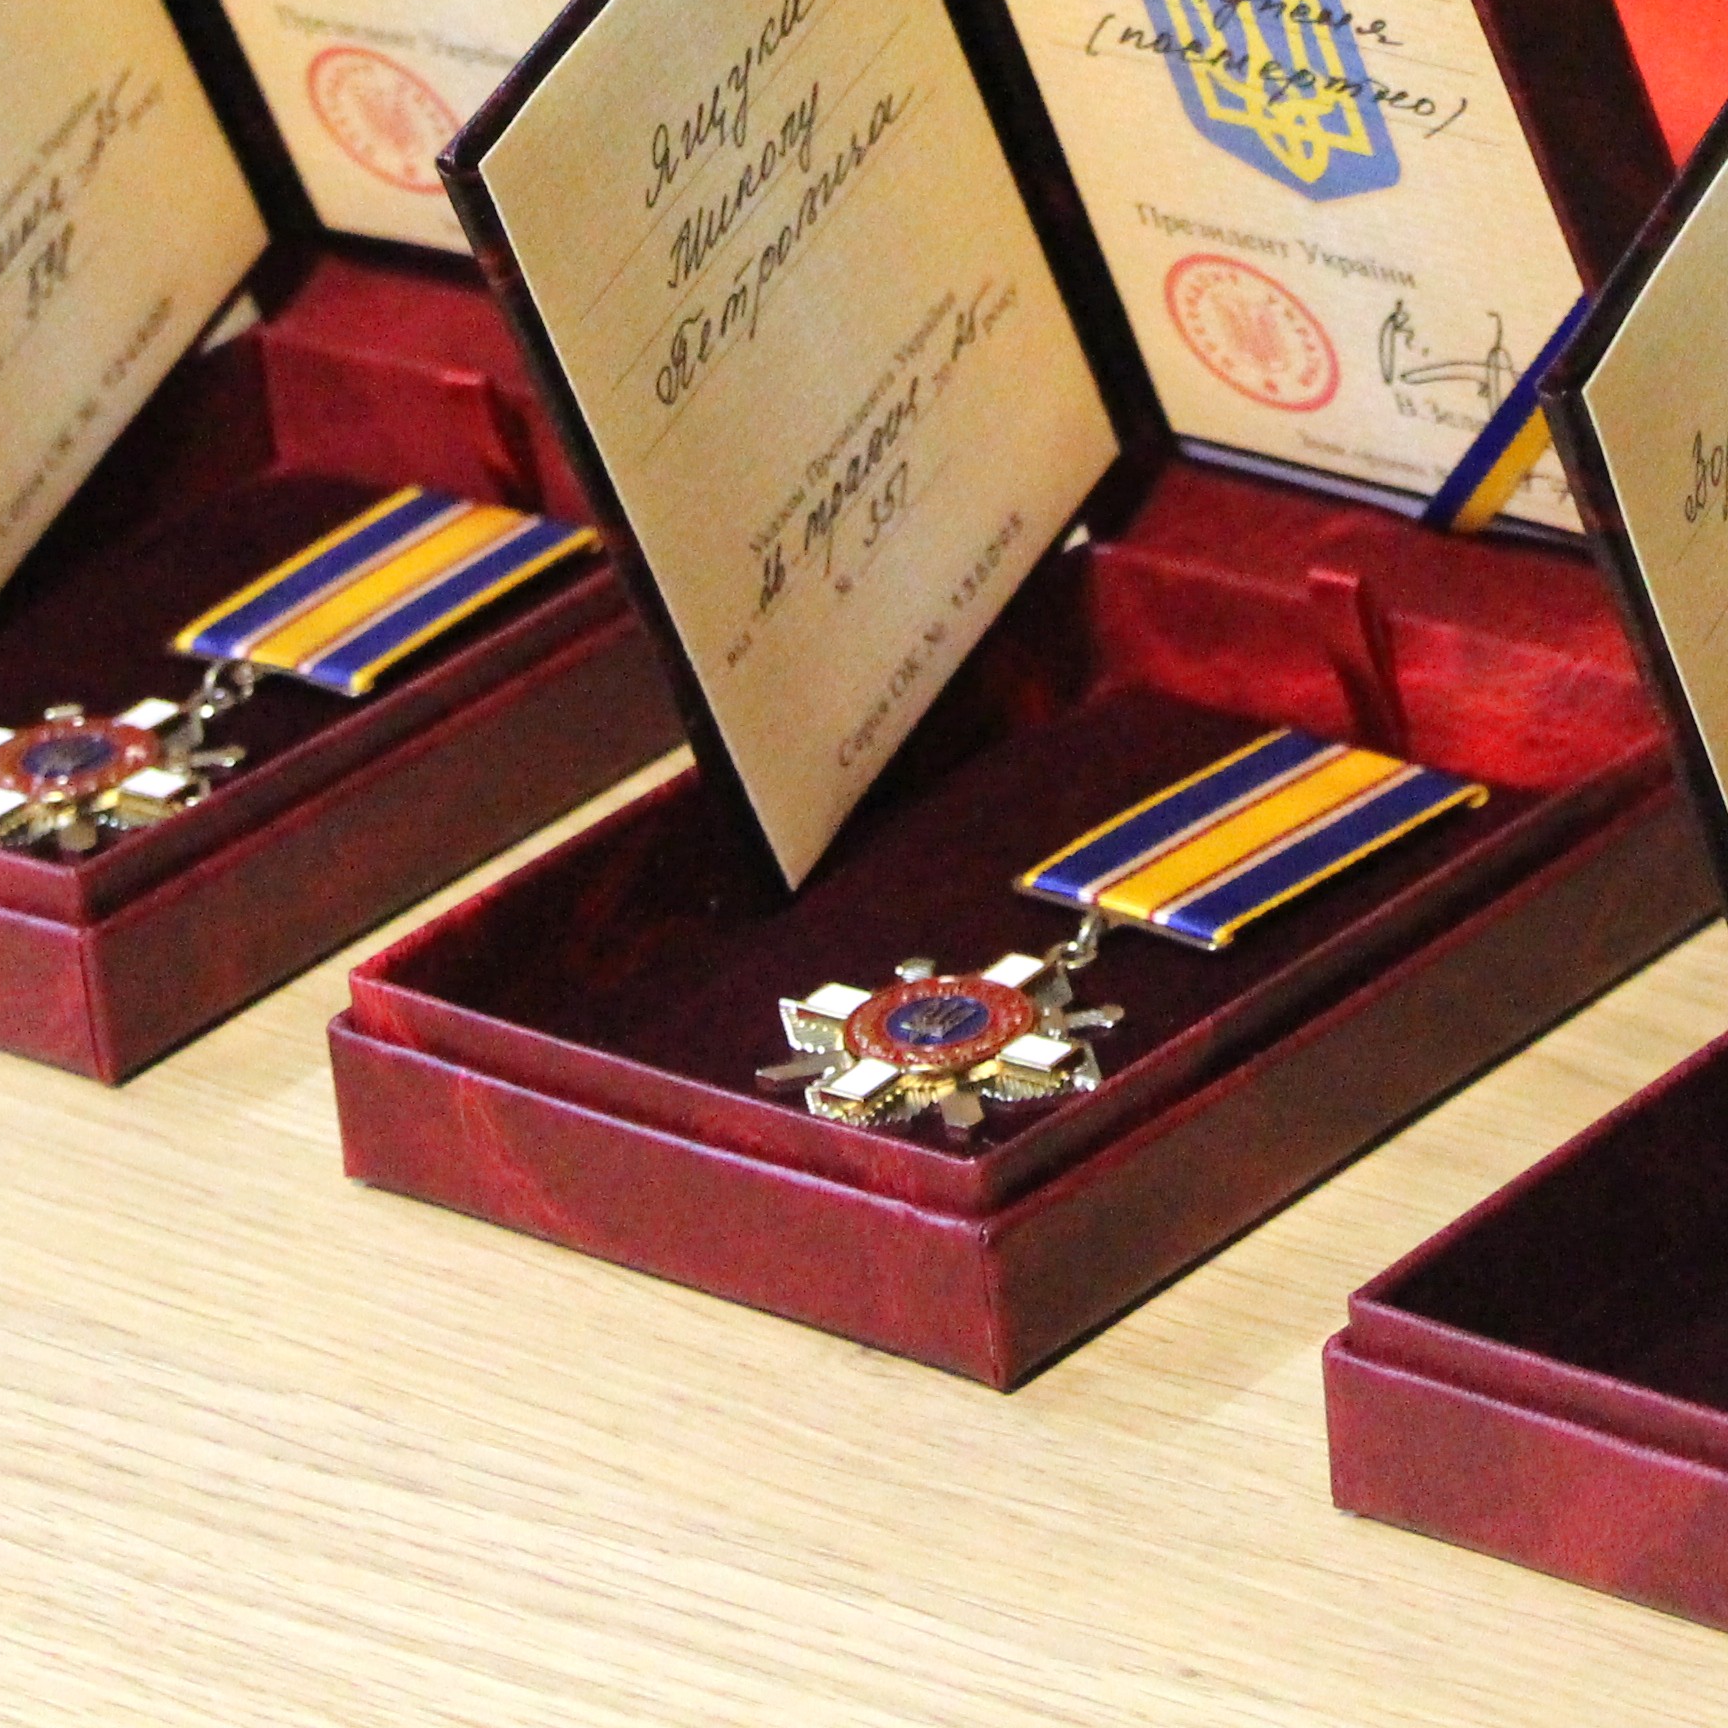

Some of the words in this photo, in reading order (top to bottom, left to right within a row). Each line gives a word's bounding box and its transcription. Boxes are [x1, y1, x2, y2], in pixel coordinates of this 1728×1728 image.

[1085, 13, 1469, 139] (посмертно)
[656, 87, 914, 407] Петровича
[1136, 202, 1289, 258] Президент
